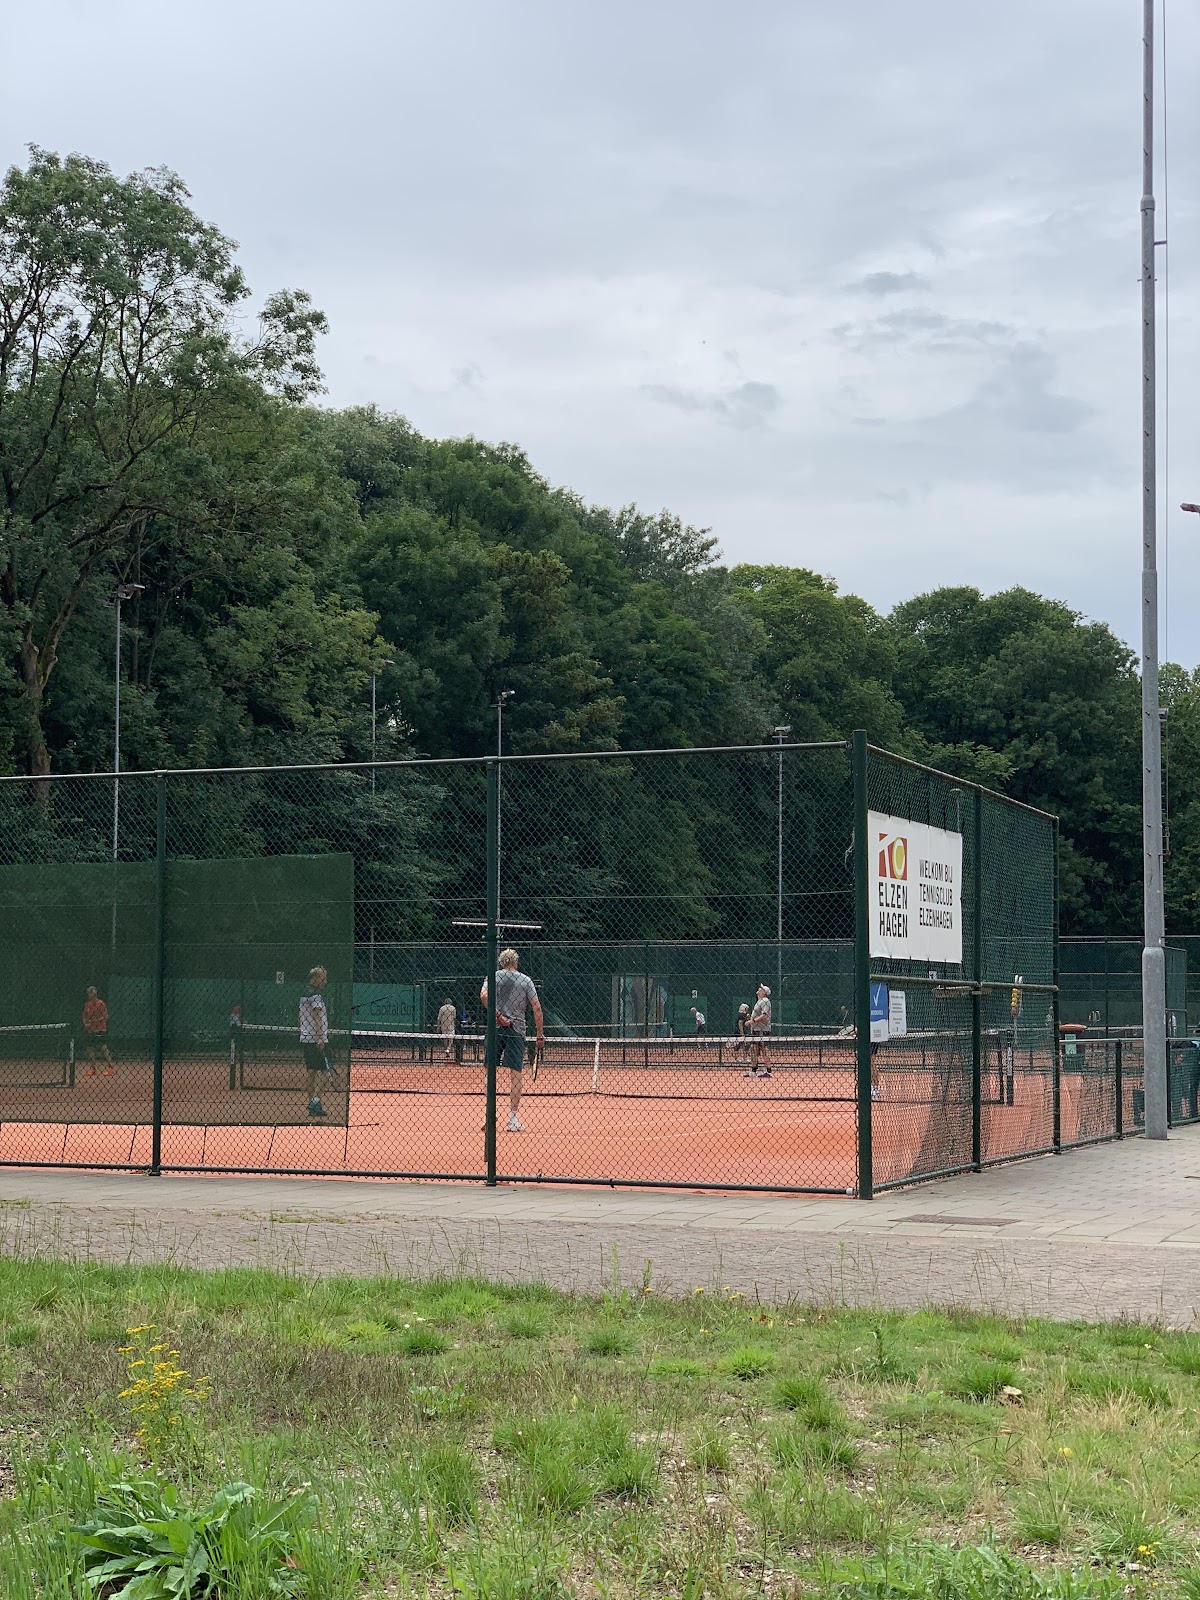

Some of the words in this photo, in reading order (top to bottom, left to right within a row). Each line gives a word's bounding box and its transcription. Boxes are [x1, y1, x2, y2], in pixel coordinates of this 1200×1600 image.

[919, 860, 944, 881] WELKOM
[945, 864, 953, 883] BIJ
[879, 882, 907, 909] ELZEN
[919, 883, 953, 906] TENNISCLUB
[879, 911, 908, 938] HAGEN
[919, 907, 953, 930] ELZENHAGEN
